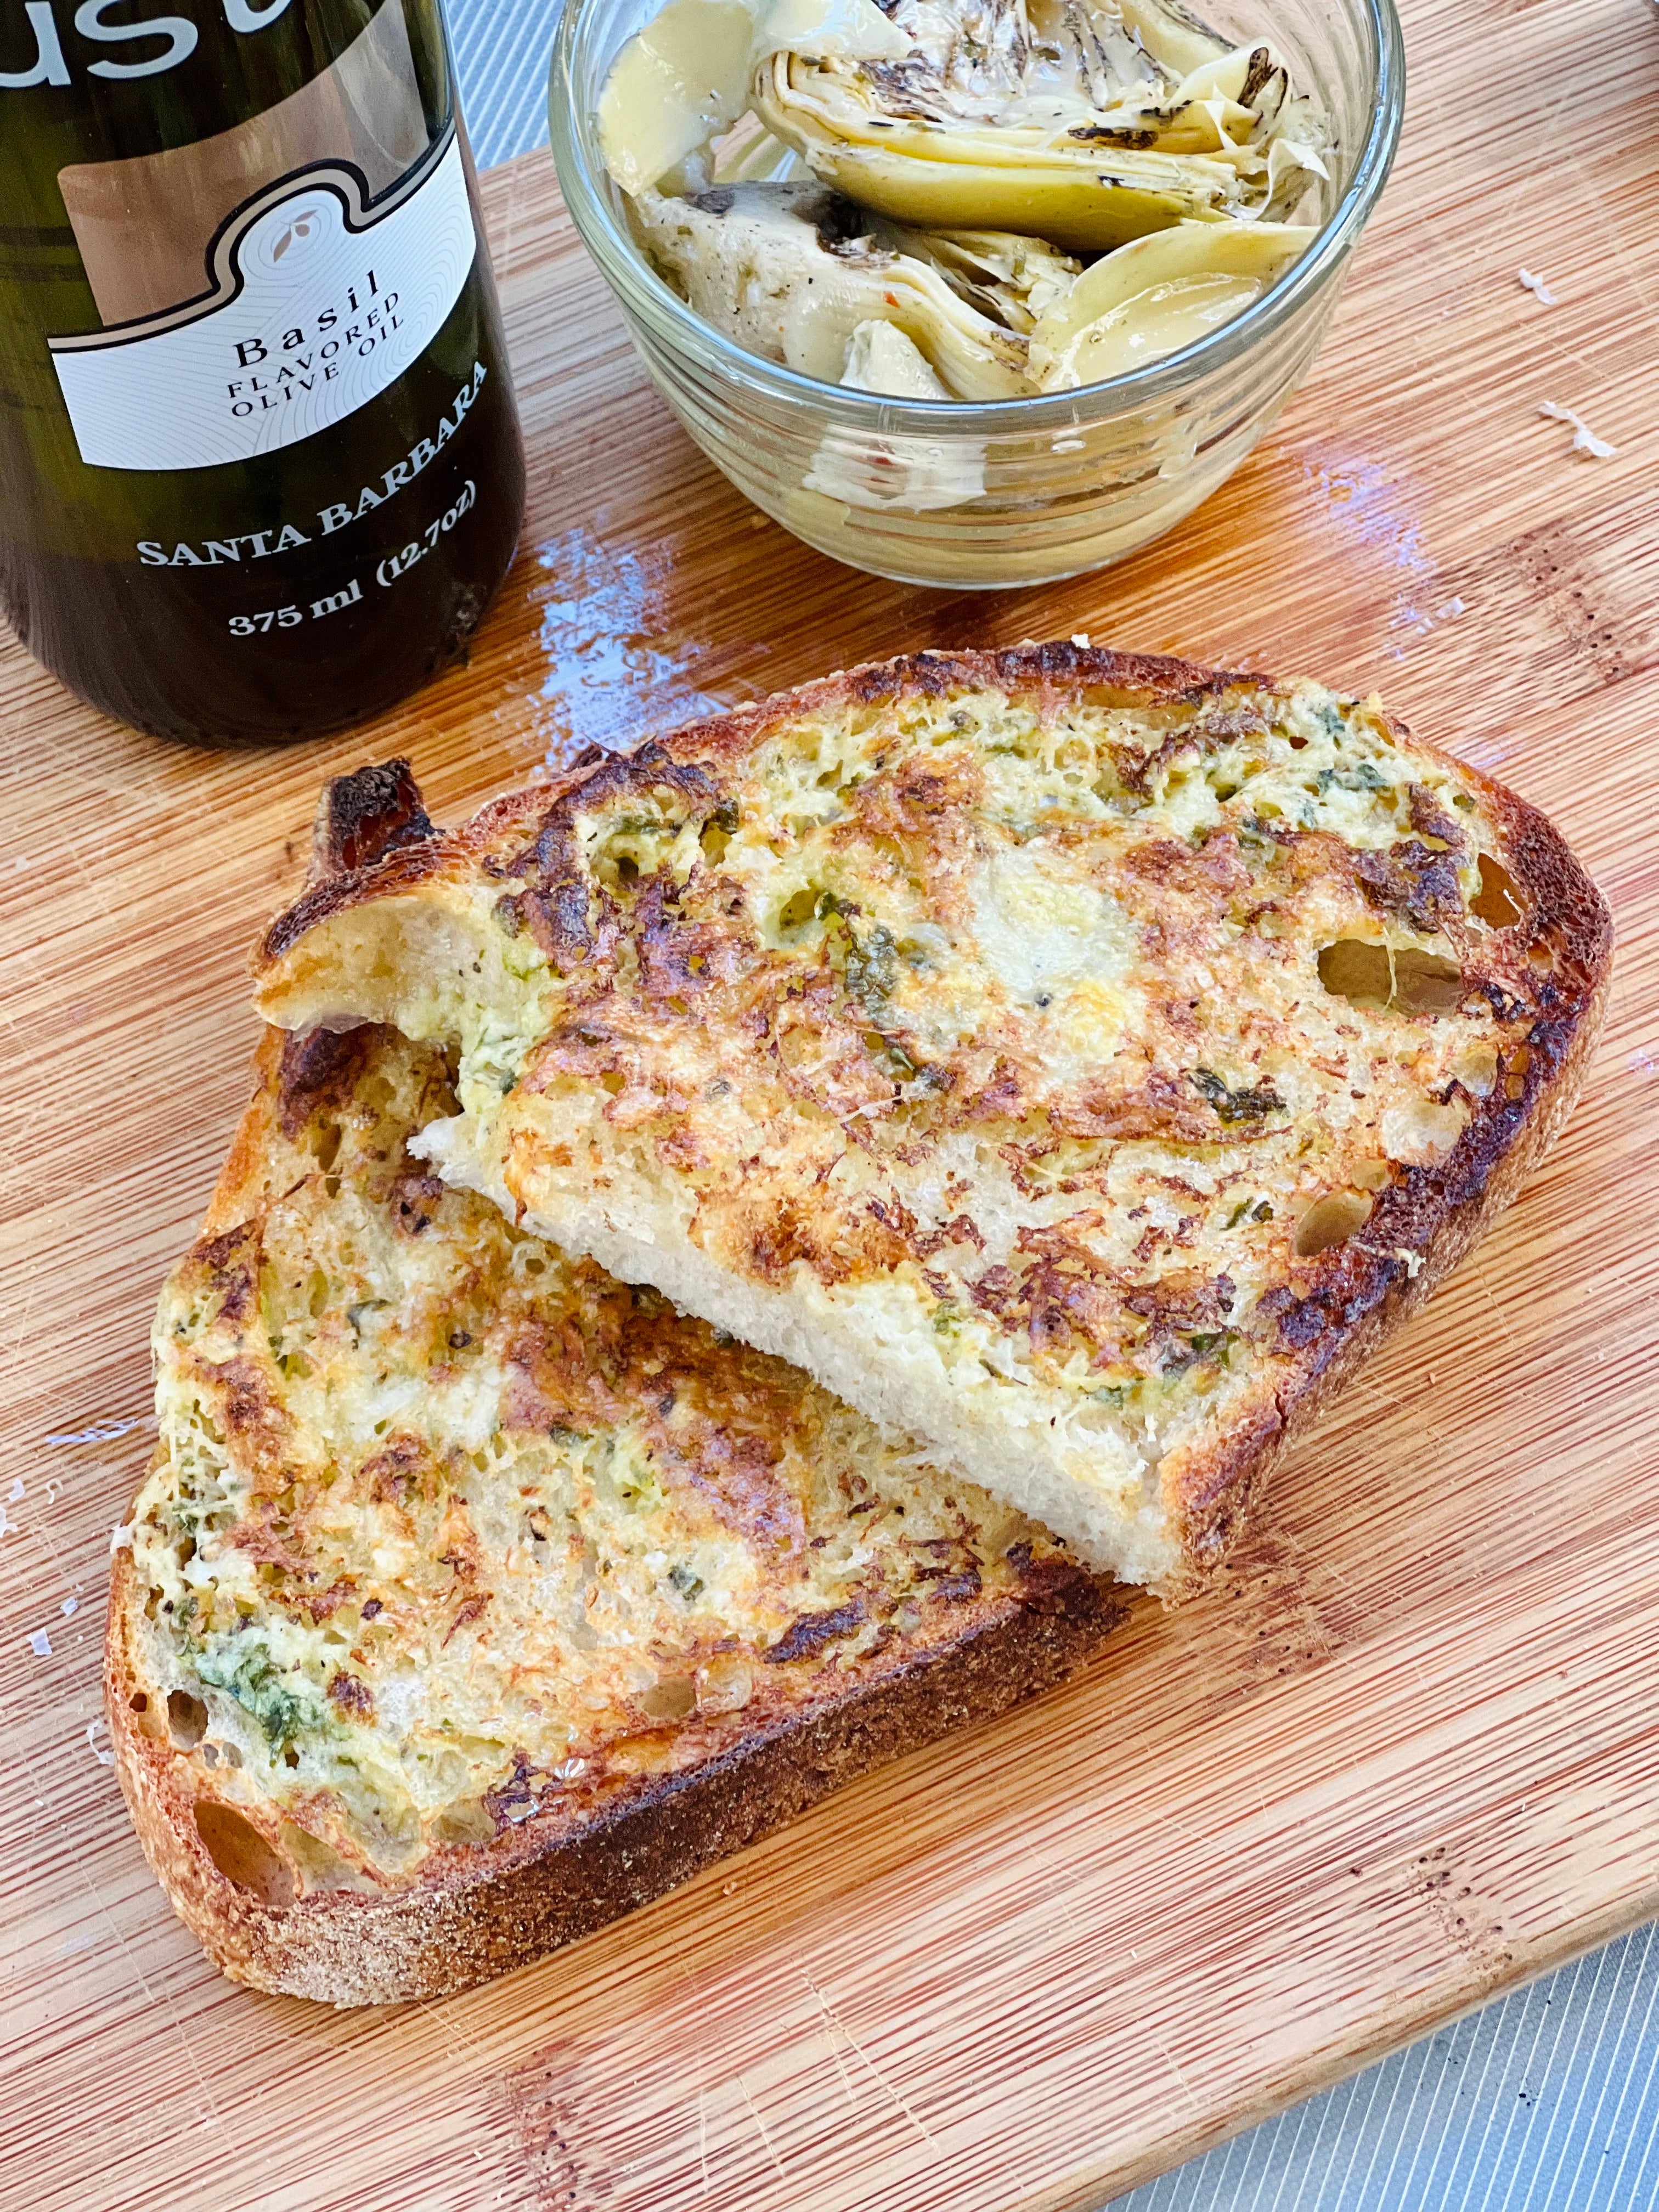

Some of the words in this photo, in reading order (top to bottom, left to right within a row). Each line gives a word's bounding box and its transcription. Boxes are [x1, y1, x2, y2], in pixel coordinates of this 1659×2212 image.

[227, 292, 399, 399] FLAVORED
[232, 362, 339, 417] OLIVE
[358, 315, 404, 357] OIL
[233, 269, 379, 368] Basil
[136, 524, 312, 567] SANTA
[317, 361, 487, 536] BARBARA
[228, 605, 303, 636] 375
[309, 579, 364, 619] ml
[376, 479, 477, 588] (12.7oz)
